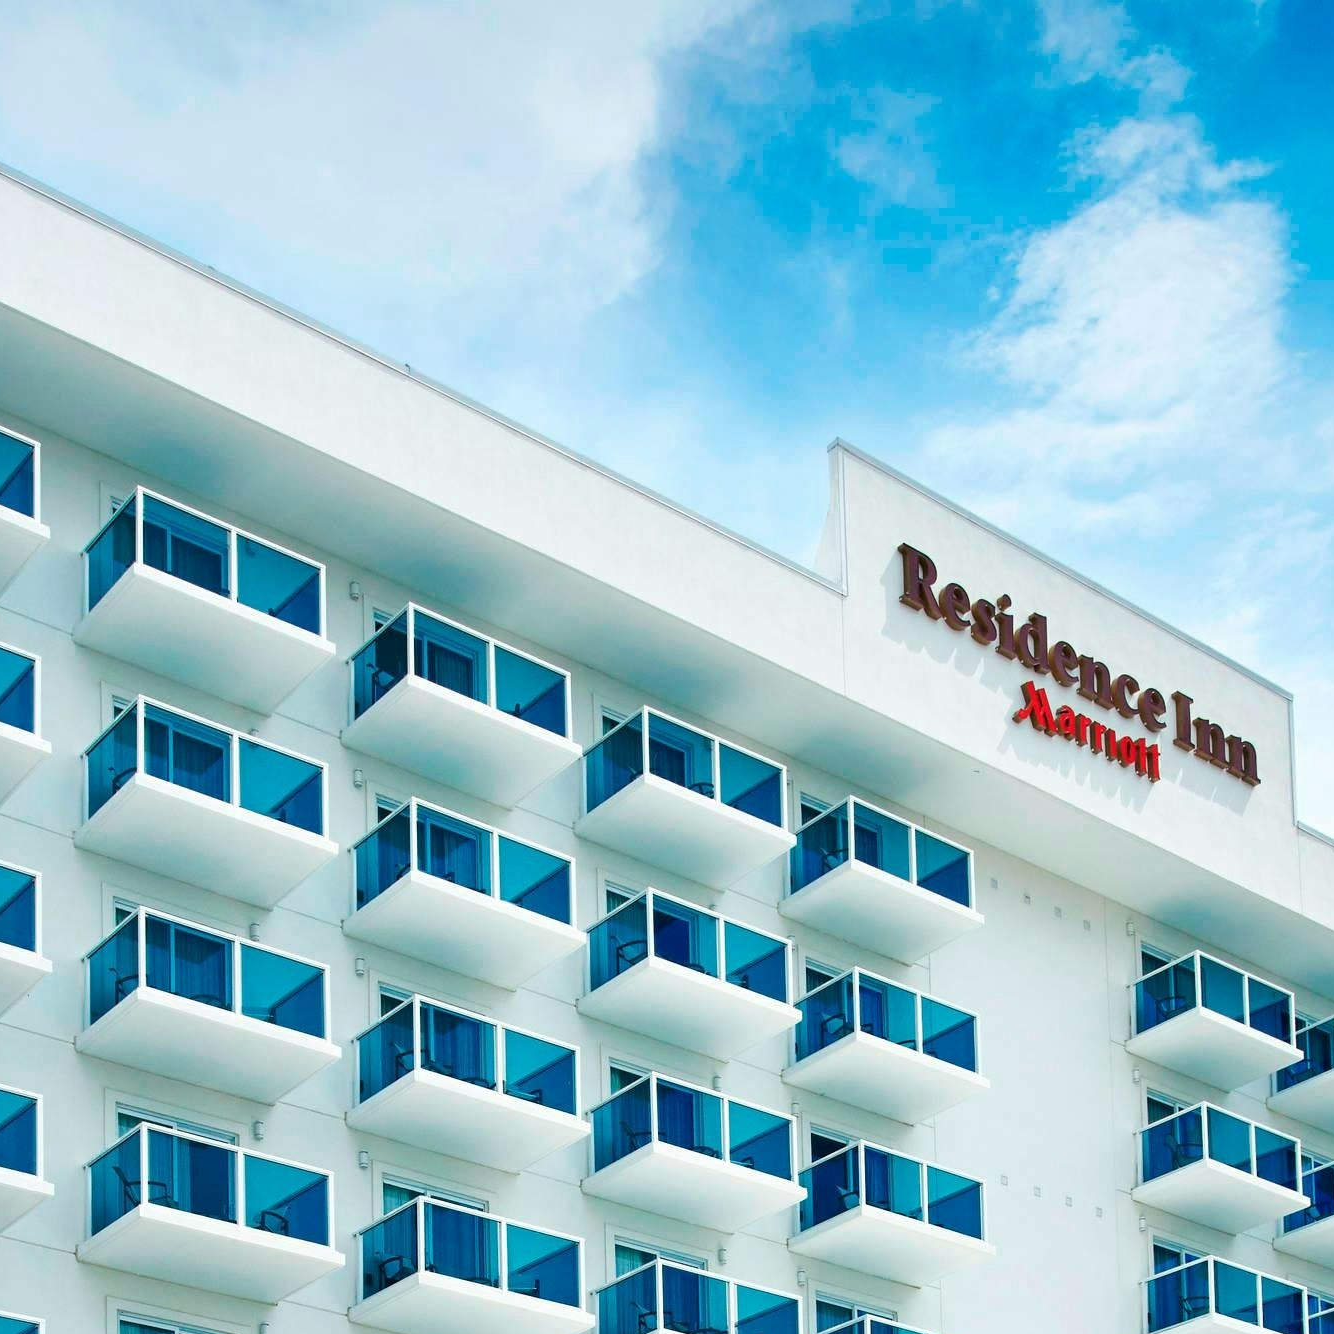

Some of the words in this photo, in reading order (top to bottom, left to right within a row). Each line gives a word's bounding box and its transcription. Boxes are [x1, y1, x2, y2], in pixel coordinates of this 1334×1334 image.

[897, 542, 1167, 733] Residence
[1171, 691, 1262, 787] Inn
[1012, 680, 1161, 783] Marriott
